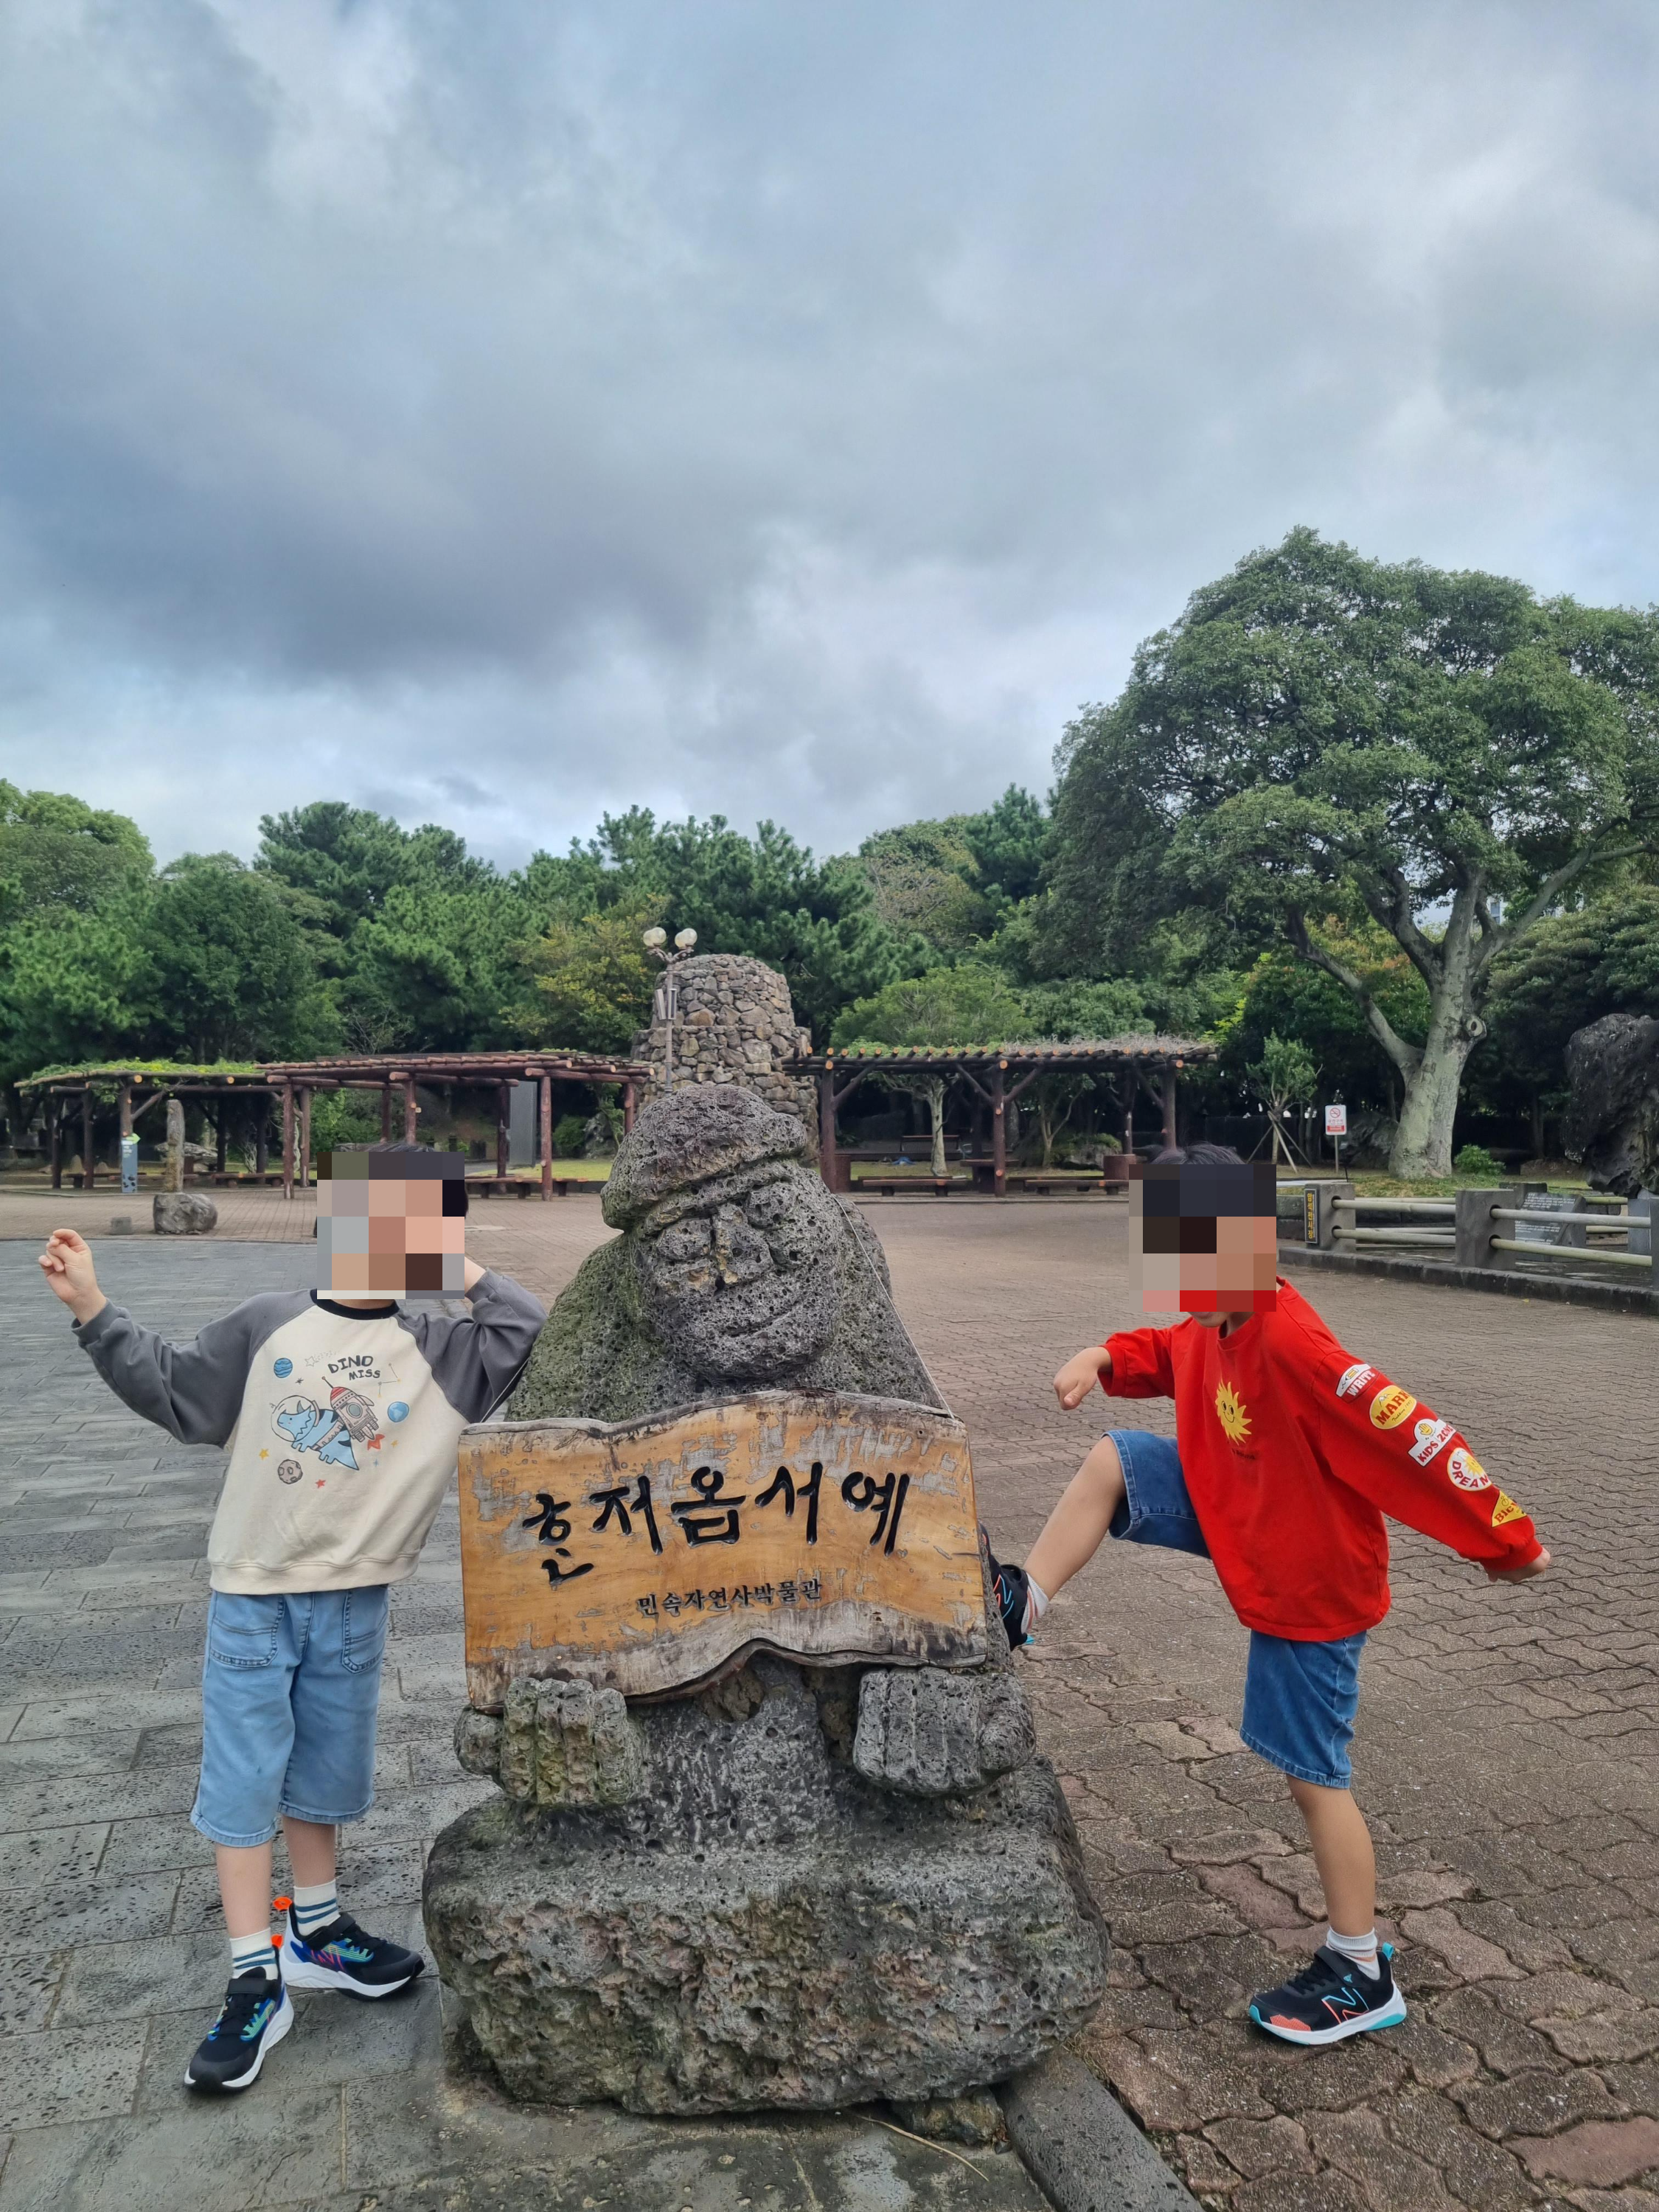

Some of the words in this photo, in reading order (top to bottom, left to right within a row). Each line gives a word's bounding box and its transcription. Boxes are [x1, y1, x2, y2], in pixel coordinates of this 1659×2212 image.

[349, 1369, 380, 1381] MISS
[1417, 1441, 1439, 1463] KIDS
[639, 1579, 822, 1616] 민속자연사박물관
